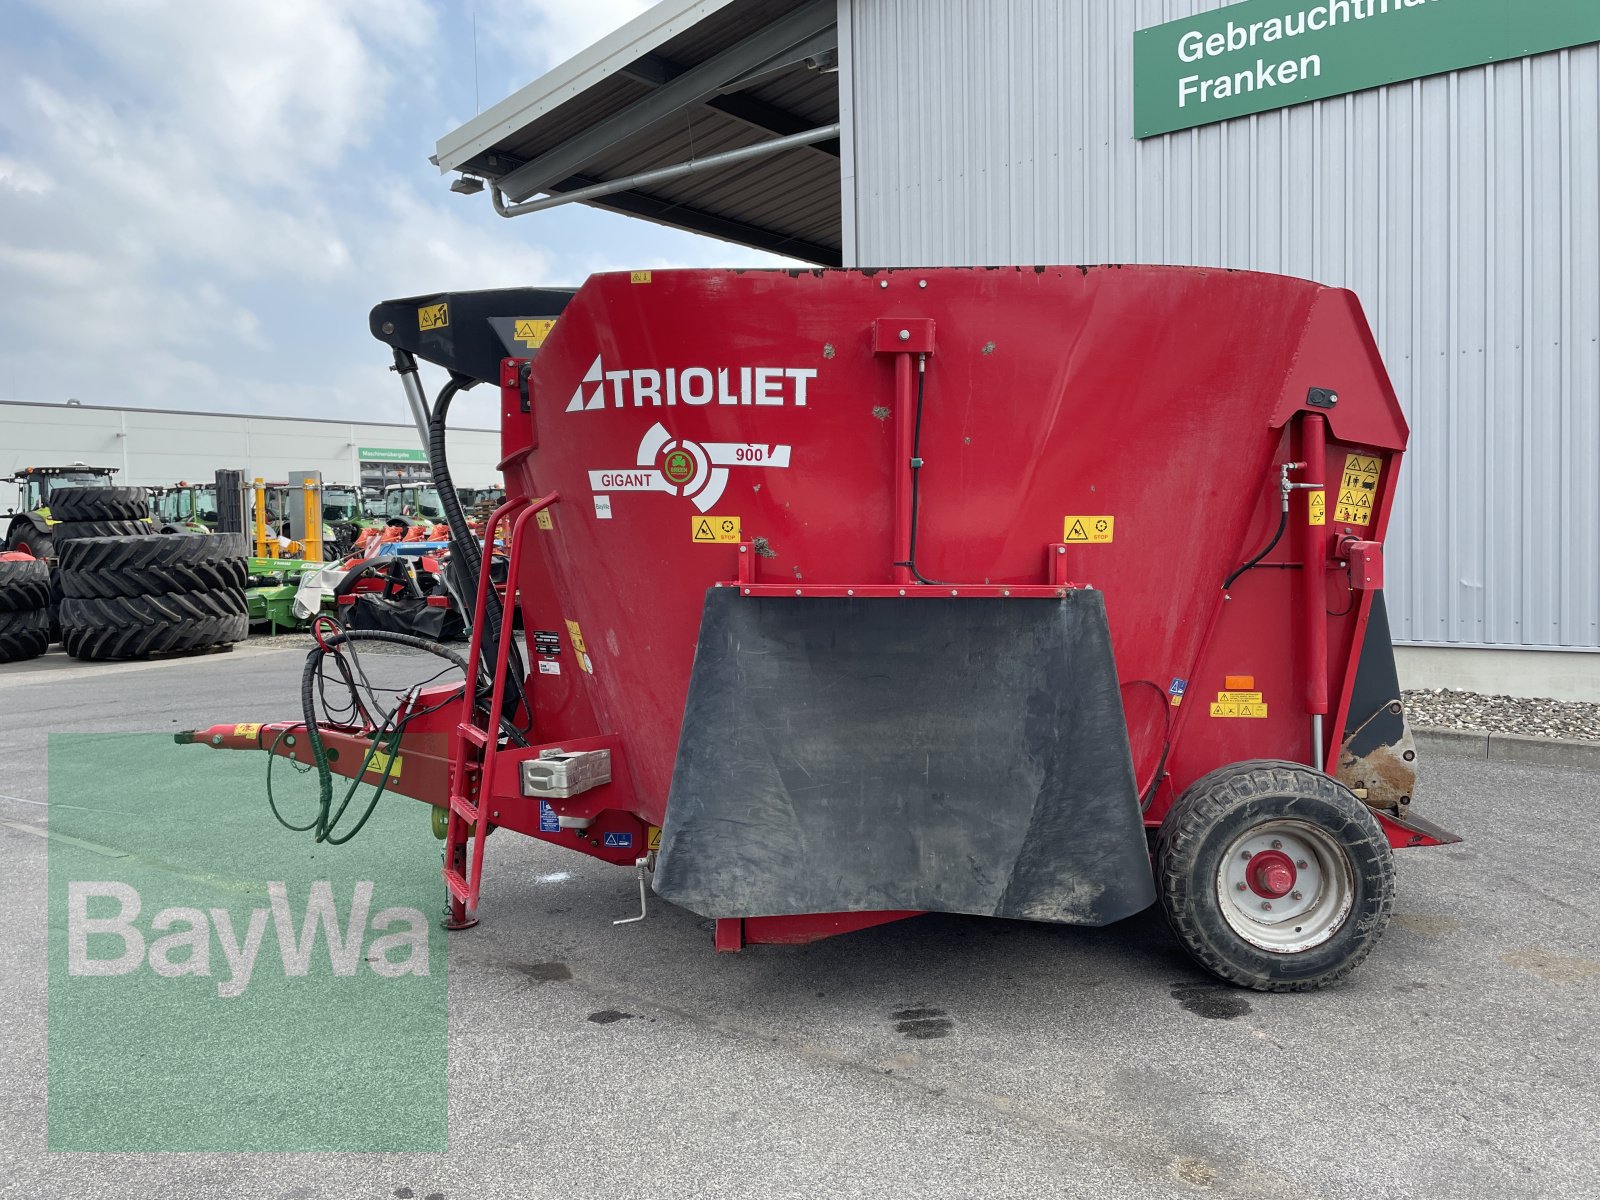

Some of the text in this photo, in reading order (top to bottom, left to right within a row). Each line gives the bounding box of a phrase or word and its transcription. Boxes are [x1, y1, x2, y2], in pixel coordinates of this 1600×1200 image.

[1177, 53, 1322, 107] Franken
[605, 367, 818, 408] TRIOLIET
[735, 448, 763, 462] 900
[601, 474, 652, 487] GIGANT
